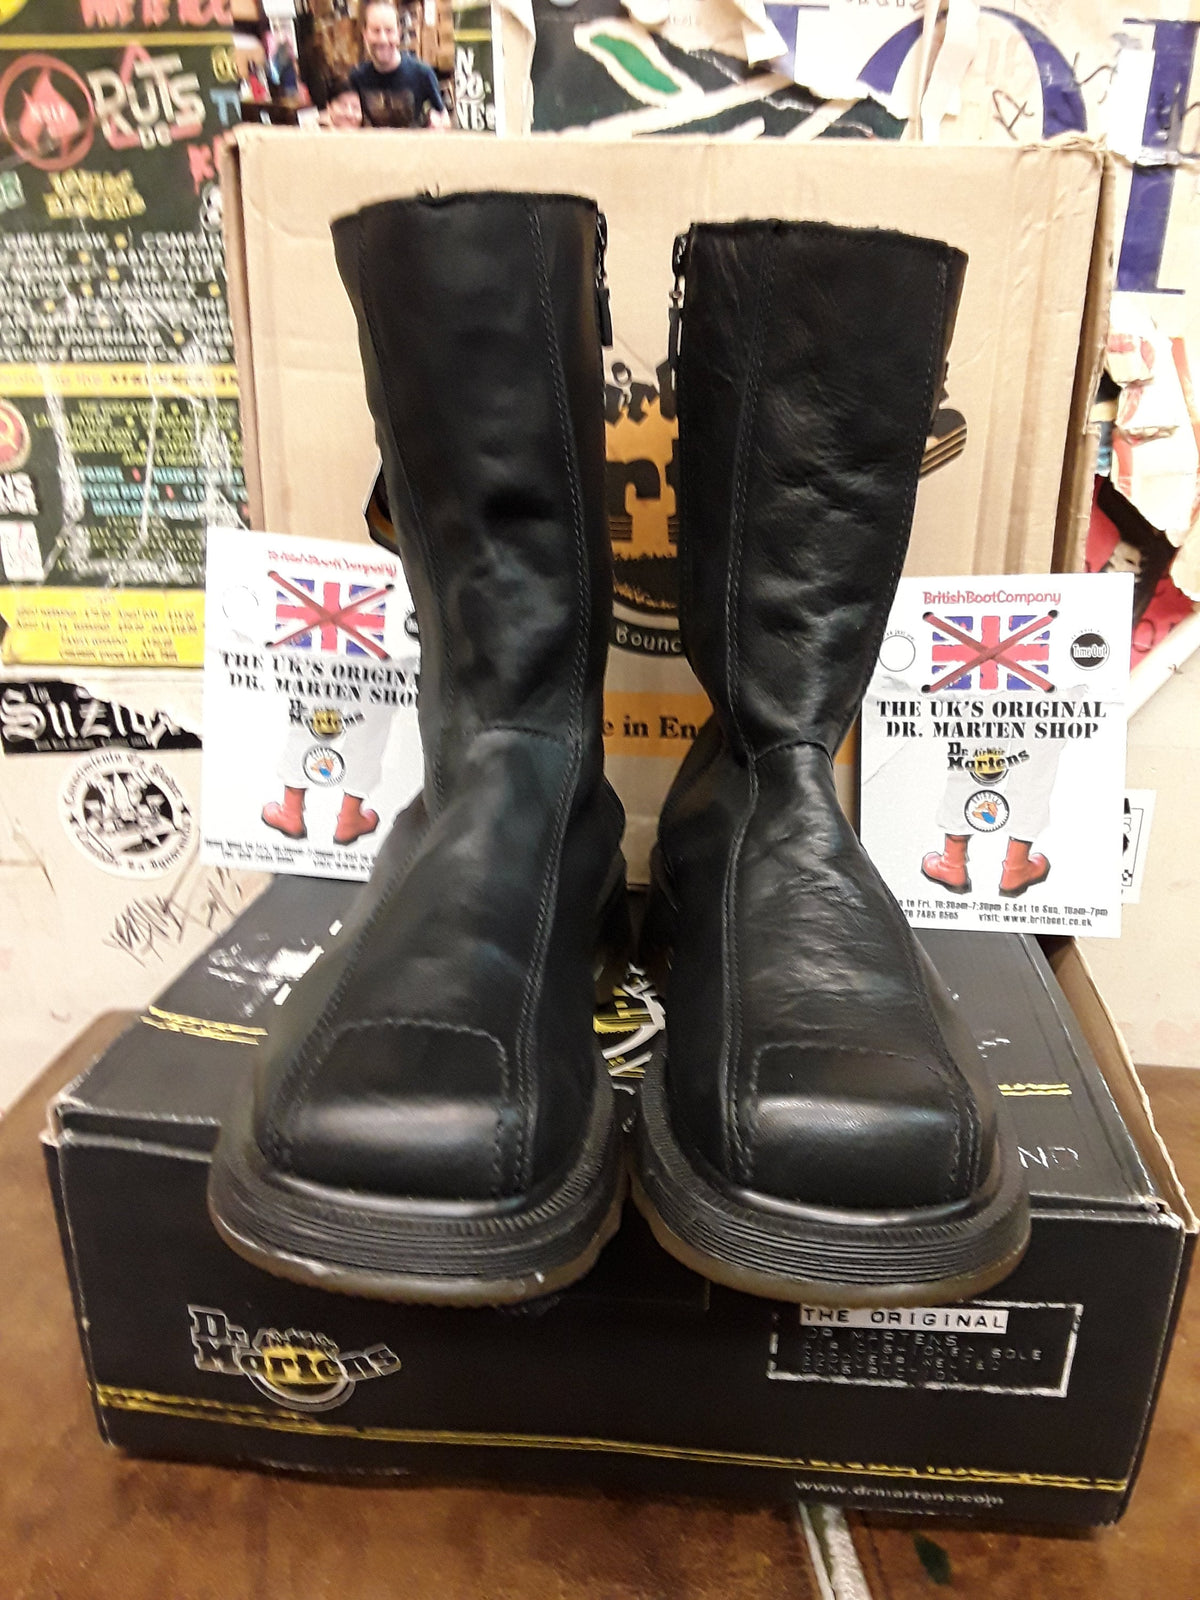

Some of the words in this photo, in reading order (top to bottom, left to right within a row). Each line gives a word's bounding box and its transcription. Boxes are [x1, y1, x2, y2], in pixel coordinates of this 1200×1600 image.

[86, 52, 206, 140] RUTS
[877, 701, 922, 718] THE
[930, 701, 984, 718] UK'S
[992, 701, 1107, 718] ORIGINAL
[623, 713, 649, 738] in
[886, 722, 923, 738] DR.
[933, 722, 1026, 739] MARTEN
[1034, 721, 1099, 739] SHOP
[947, 749, 1031, 771] Martens
[1031, 904, 1039, 913] to
[803, 1307, 850, 1324] THE
[870, 1310, 1005, 1330] ORIGINAL
